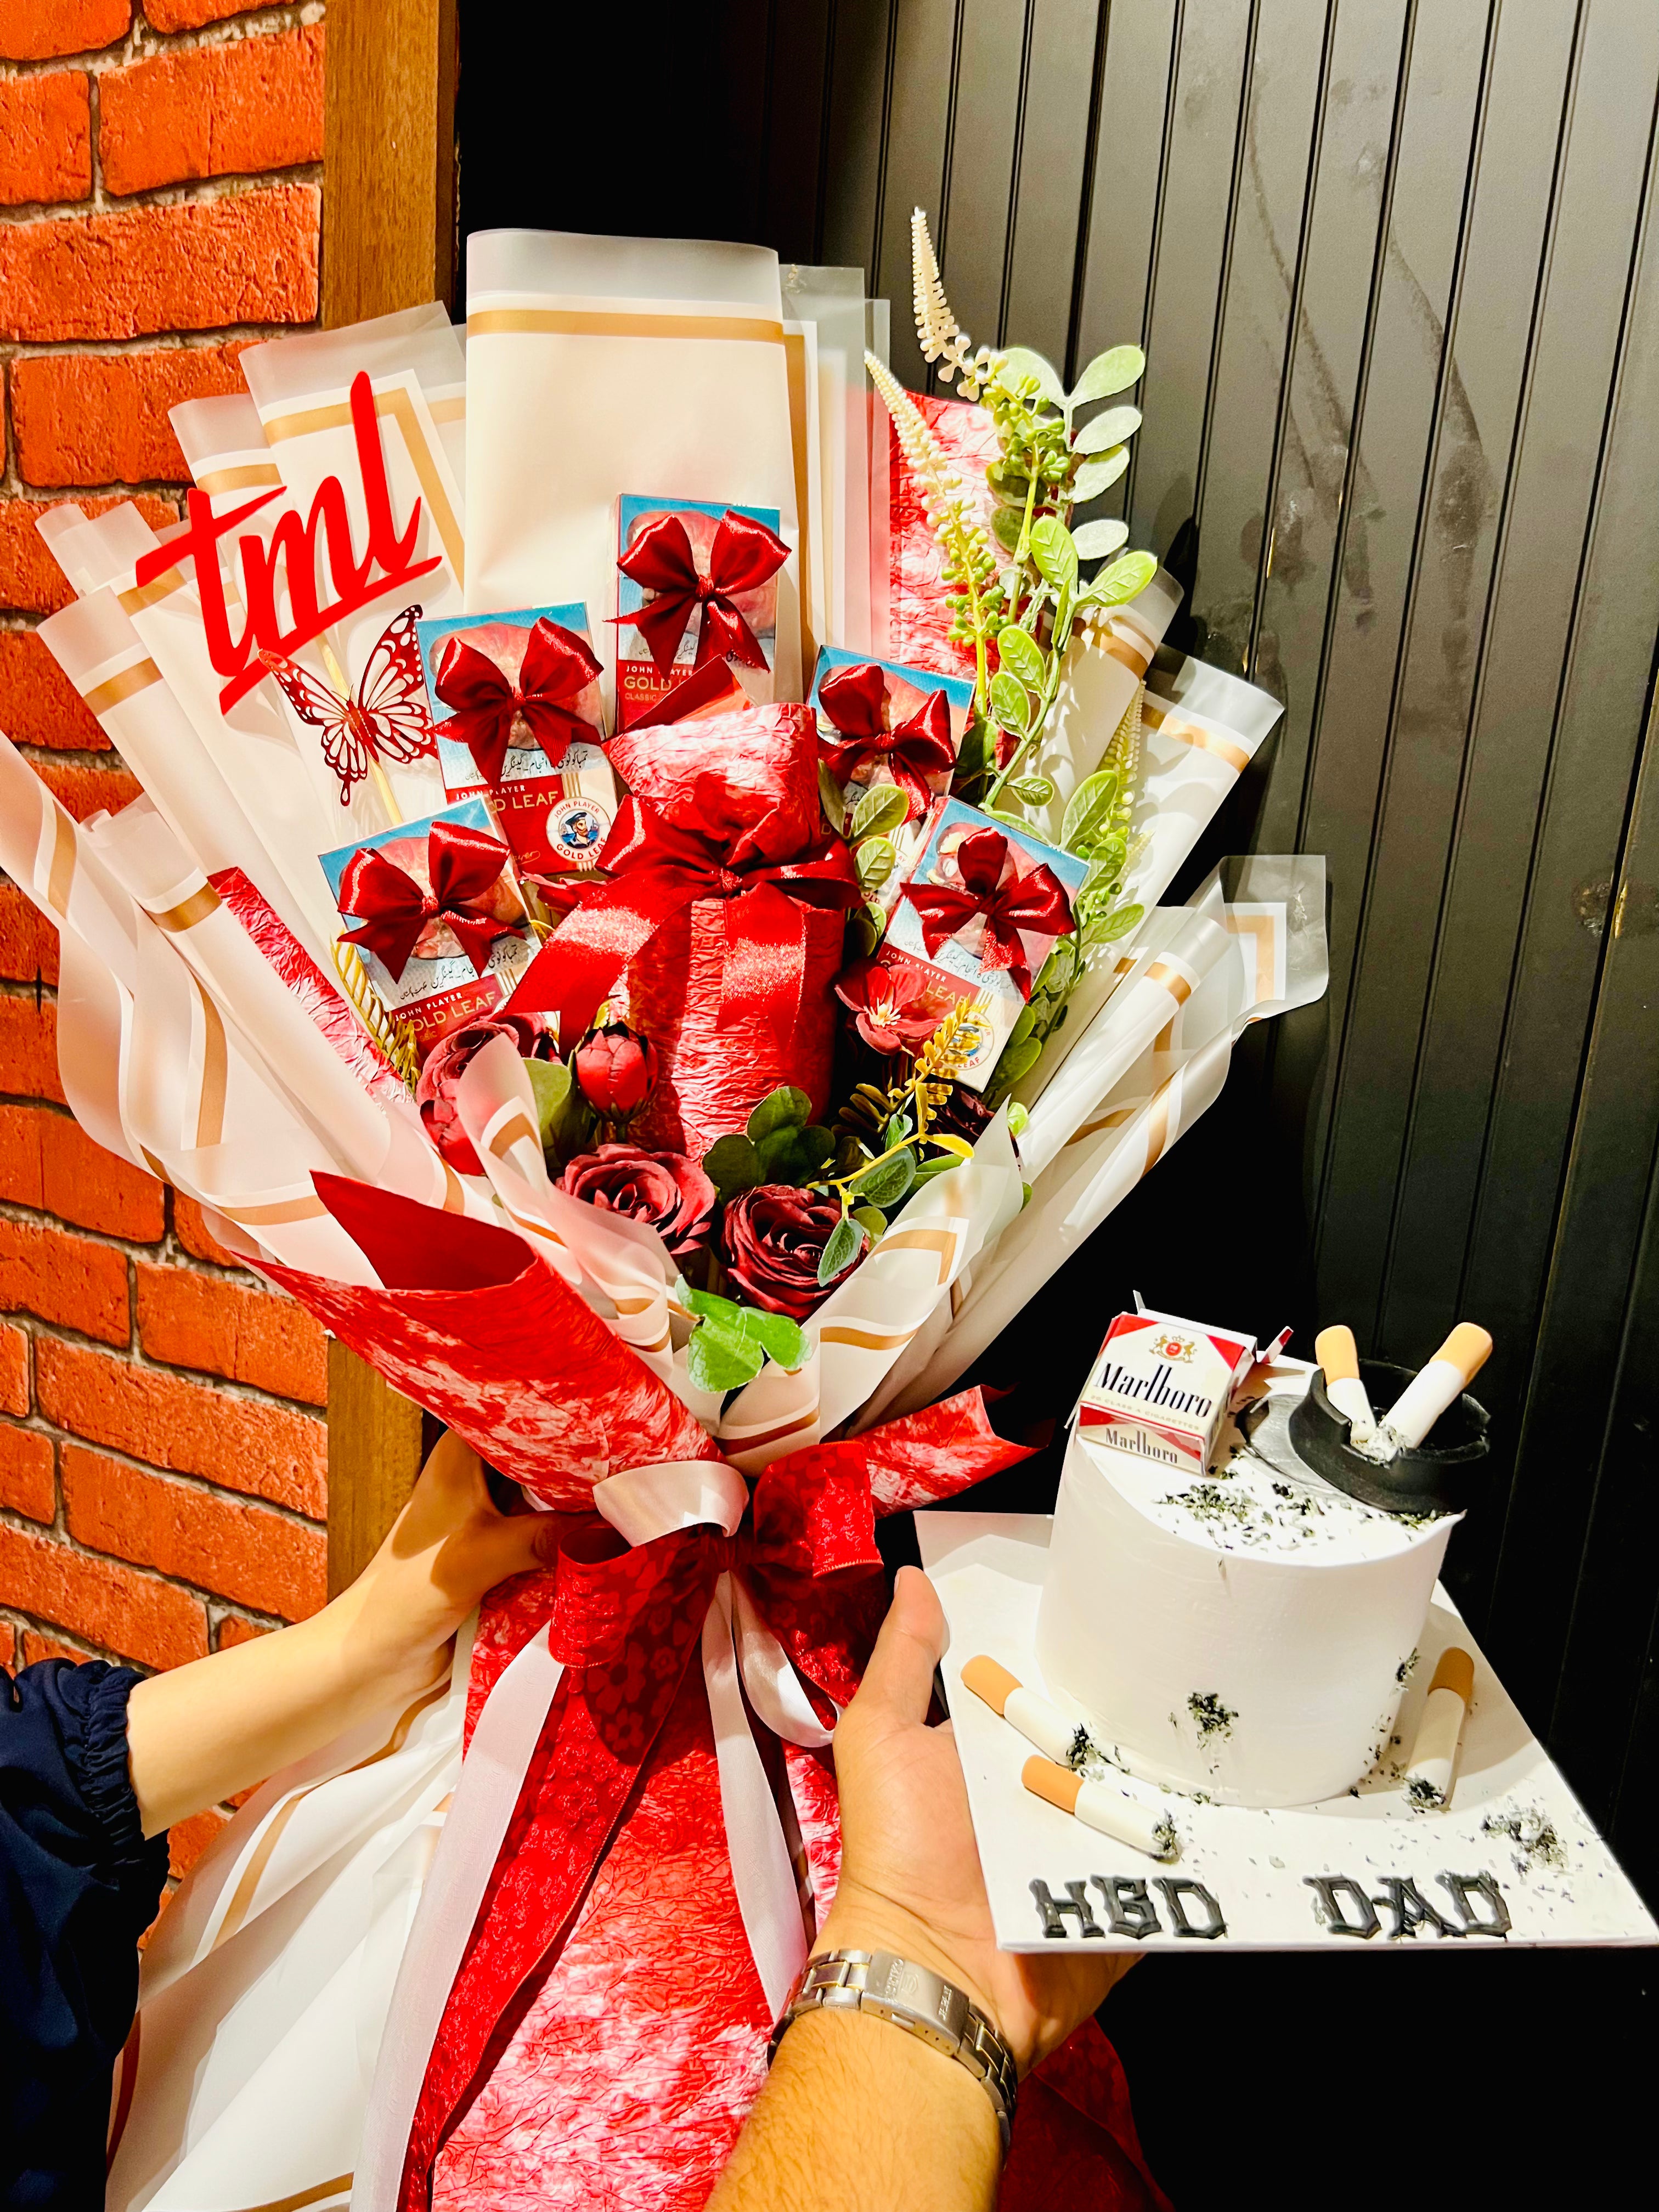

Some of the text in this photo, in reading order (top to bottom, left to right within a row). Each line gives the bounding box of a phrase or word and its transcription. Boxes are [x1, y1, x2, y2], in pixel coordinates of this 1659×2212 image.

[626, 665, 693, 676] JOHN AYER
[624, 676, 672, 691] GOLD
[625, 692, 657, 702] CLASSIC
[512, 791, 558, 810] LEAF
[554, 800, 600, 819] JOHN PLAYER
[556, 843, 584, 860] GOLD
[885, 950, 911, 965] JOHN
[395, 992, 462, 1022] JOHN PLAYER
[413, 991, 495, 1031] OLD LEAF
[1093, 1362, 1212, 1418] Marlboro
[1105, 1427, 1178, 1464] Marlboro
[1029, 1869, 1513, 1940] HBD DAD
